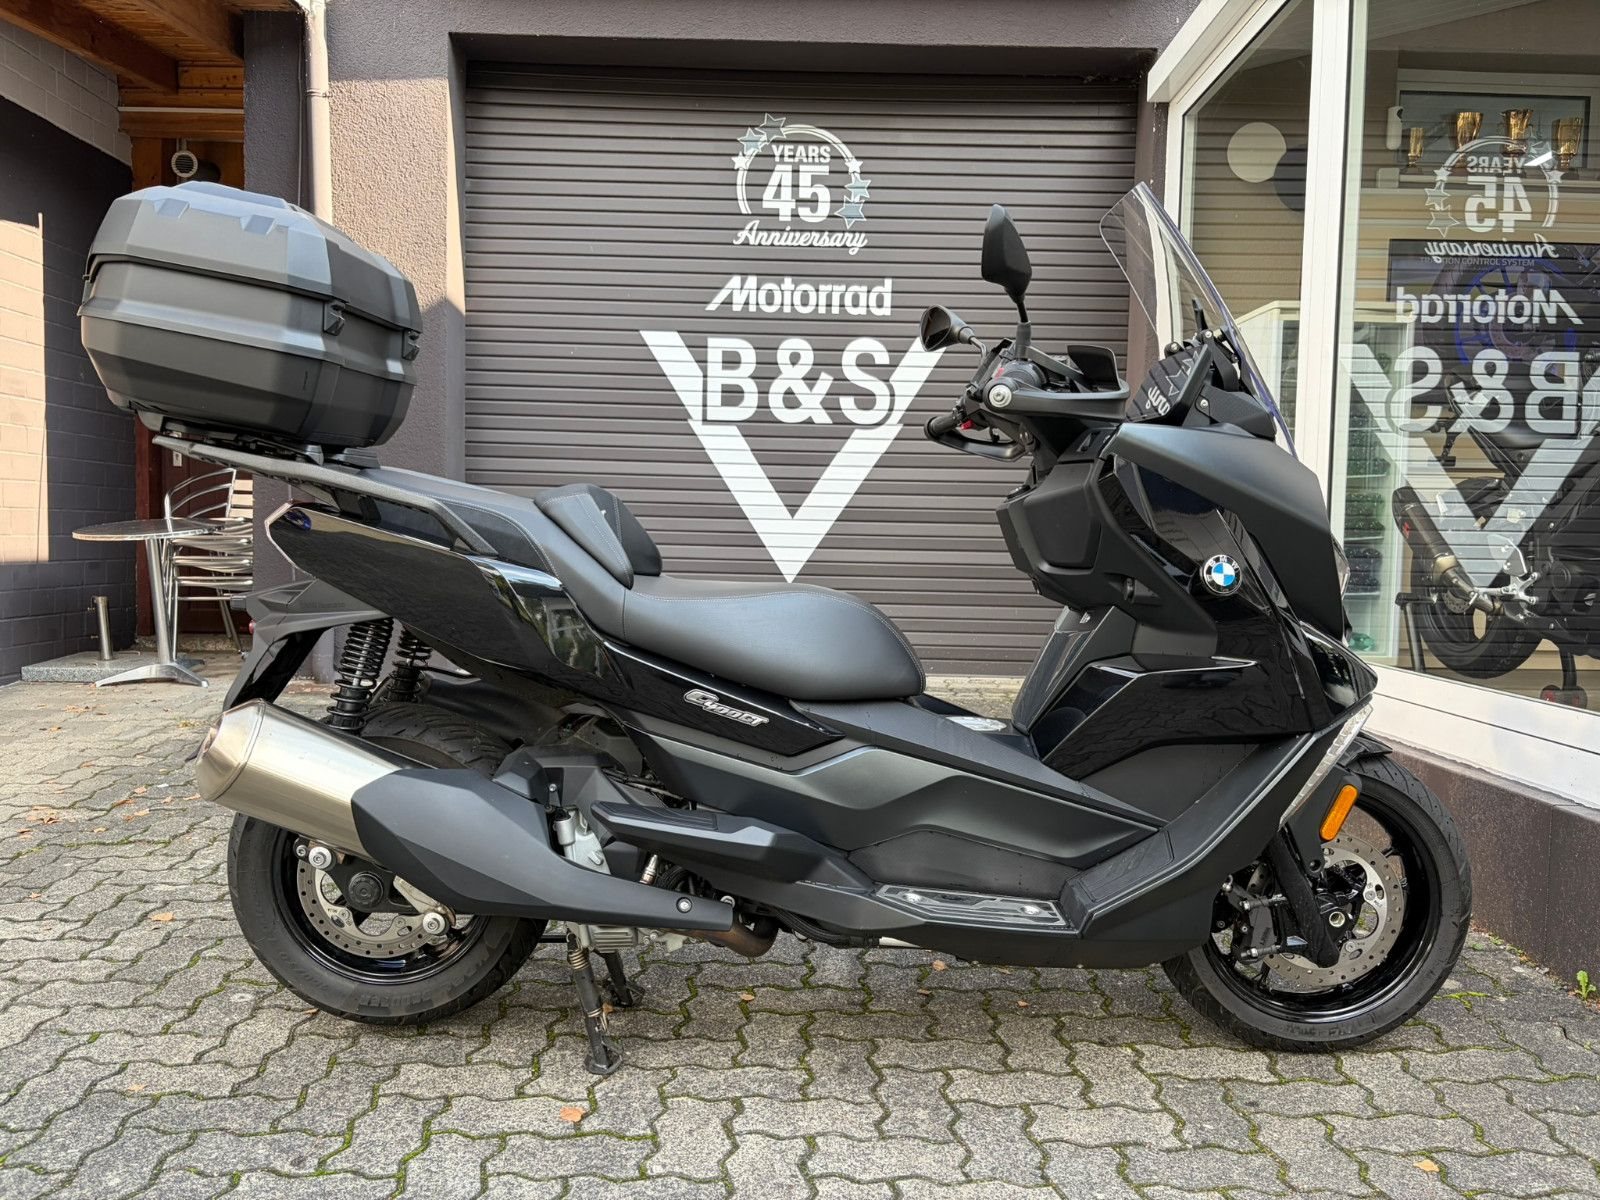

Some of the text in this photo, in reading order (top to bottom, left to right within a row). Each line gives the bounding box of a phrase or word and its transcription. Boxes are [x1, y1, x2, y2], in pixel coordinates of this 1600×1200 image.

[771, 144, 831, 164] YEARS
[762, 164, 831, 223] 45
[733, 219, 868, 255] Anniversary
[1461, 256, 1500, 266] CONTROL
[1502, 258, 1534, 267] SYSTEM
[705, 274, 893, 317] Motorrad
[706, 336, 890, 425] B&S
